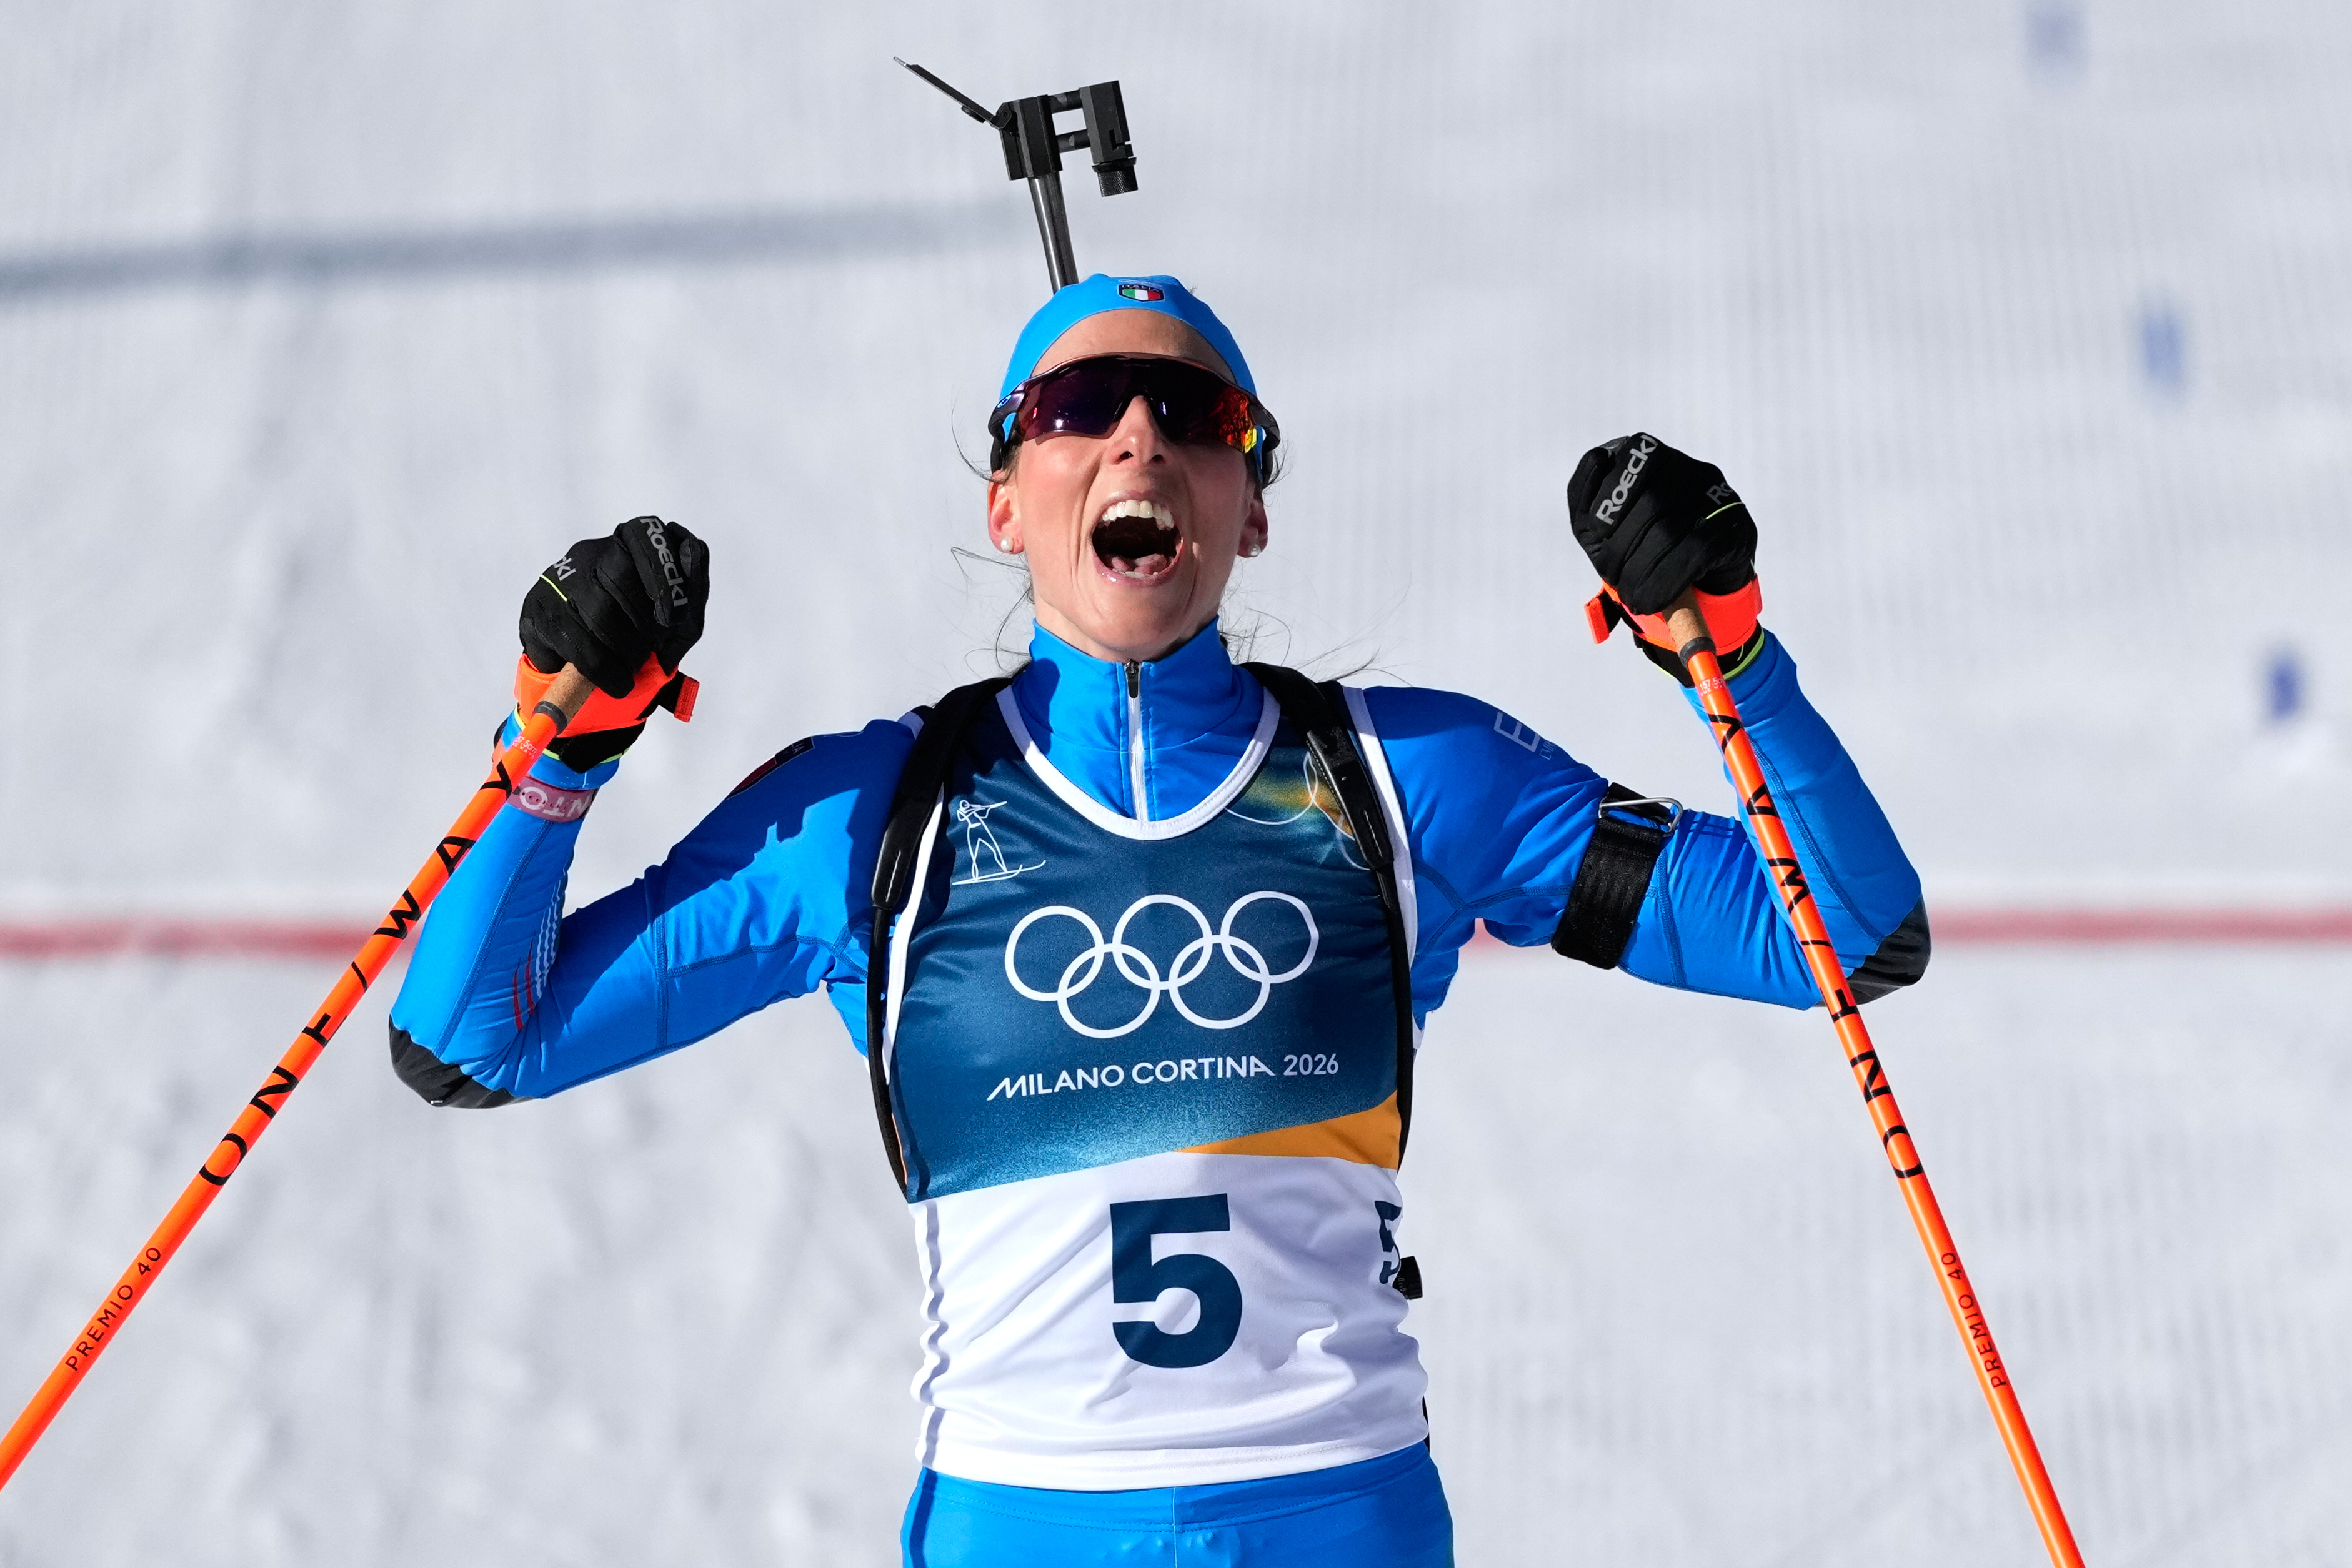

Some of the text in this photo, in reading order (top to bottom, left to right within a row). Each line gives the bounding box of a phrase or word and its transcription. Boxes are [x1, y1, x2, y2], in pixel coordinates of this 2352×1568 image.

[986, 1053, 1339, 1101] MILANO CORTINA 2026
[65, 1247, 161, 1371] PREMIO 40
[1110, 1193, 1243, 1368] 5
[1941, 1252, 2006, 1388] PREMIO 40
